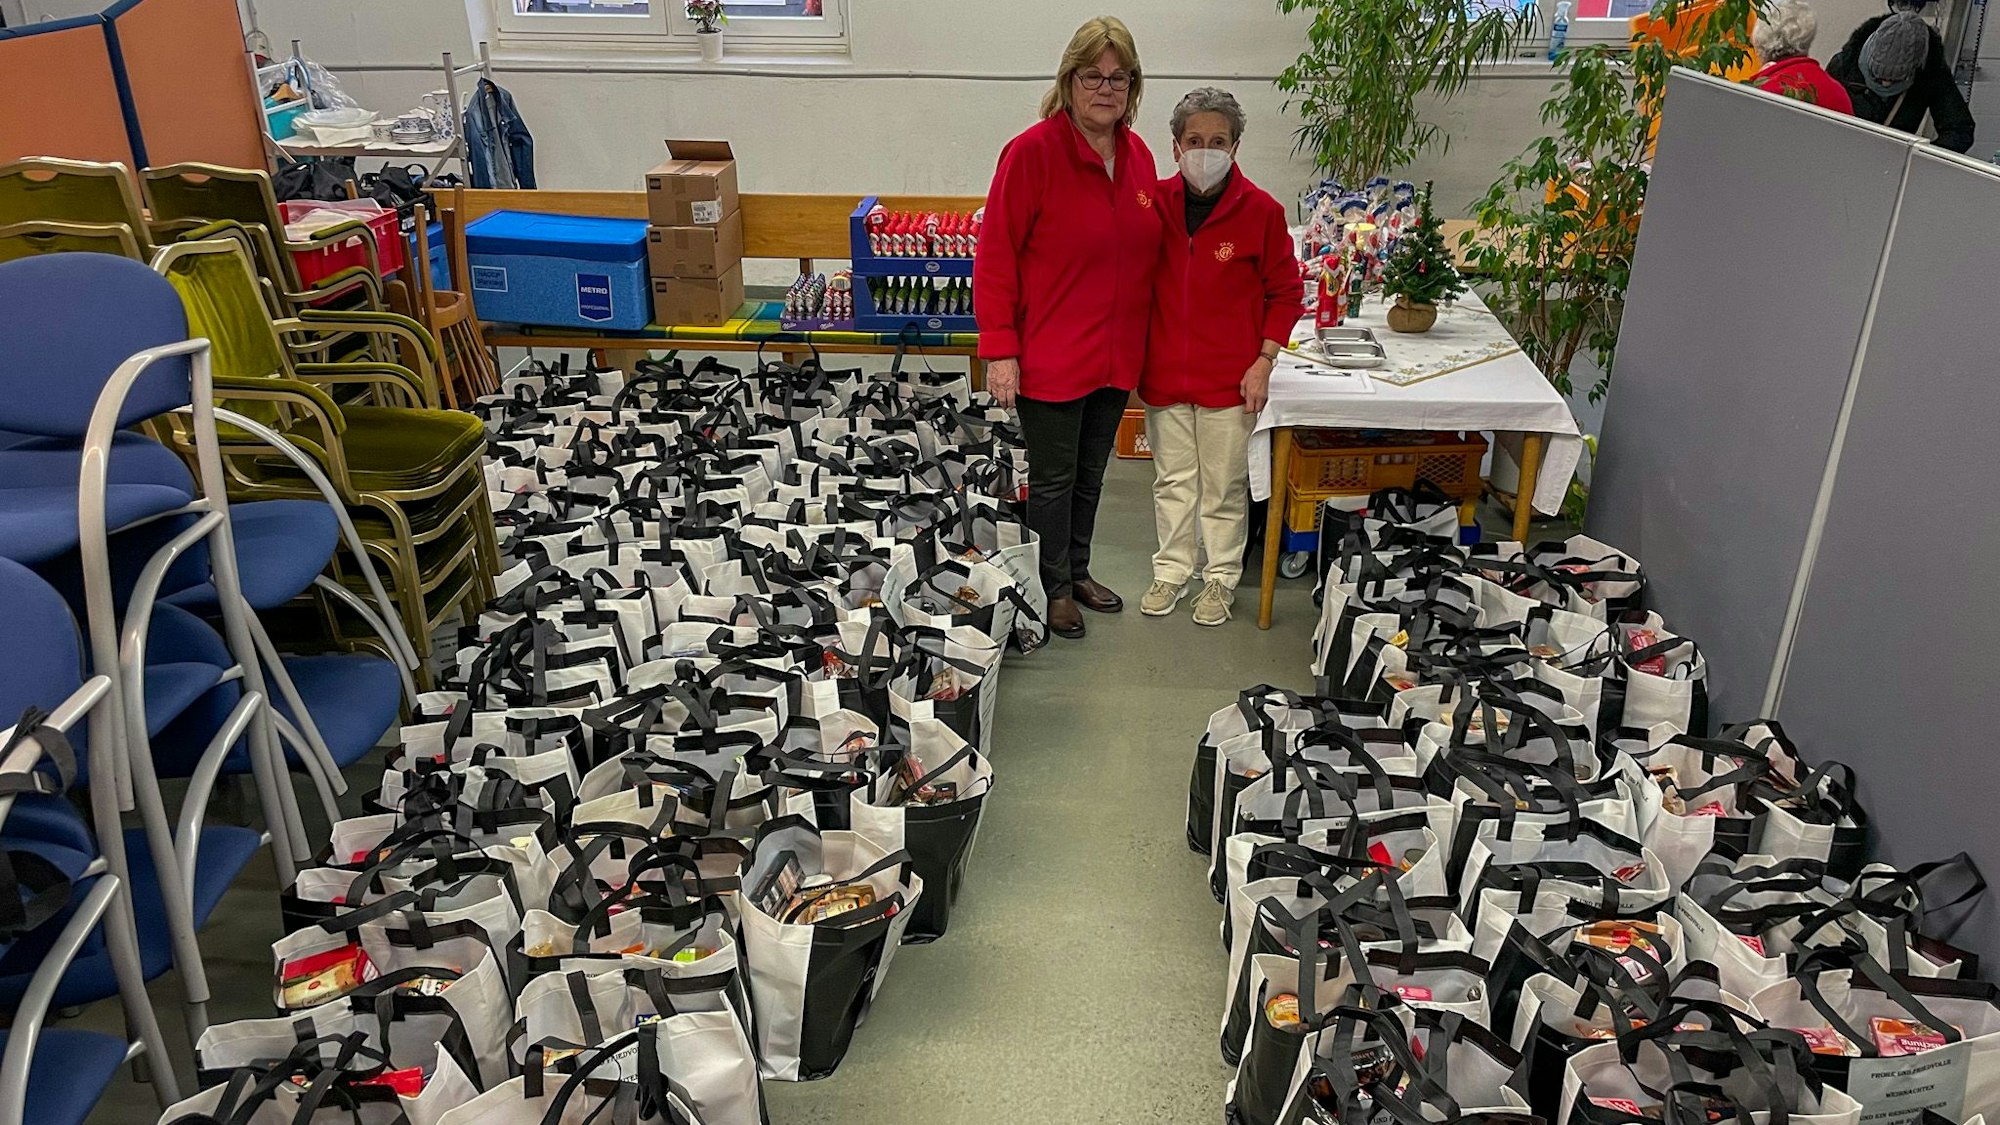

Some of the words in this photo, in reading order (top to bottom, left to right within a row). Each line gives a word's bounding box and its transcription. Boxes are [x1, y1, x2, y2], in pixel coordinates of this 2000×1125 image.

[580, 286, 608, 295] METRO
[782, 321, 797, 330] Milka
[819, 321, 835, 330] Milka
[1871, 1071, 1896, 1079] FROHE
[1885, 1084, 1936, 1098] WEIHNACHTEN
